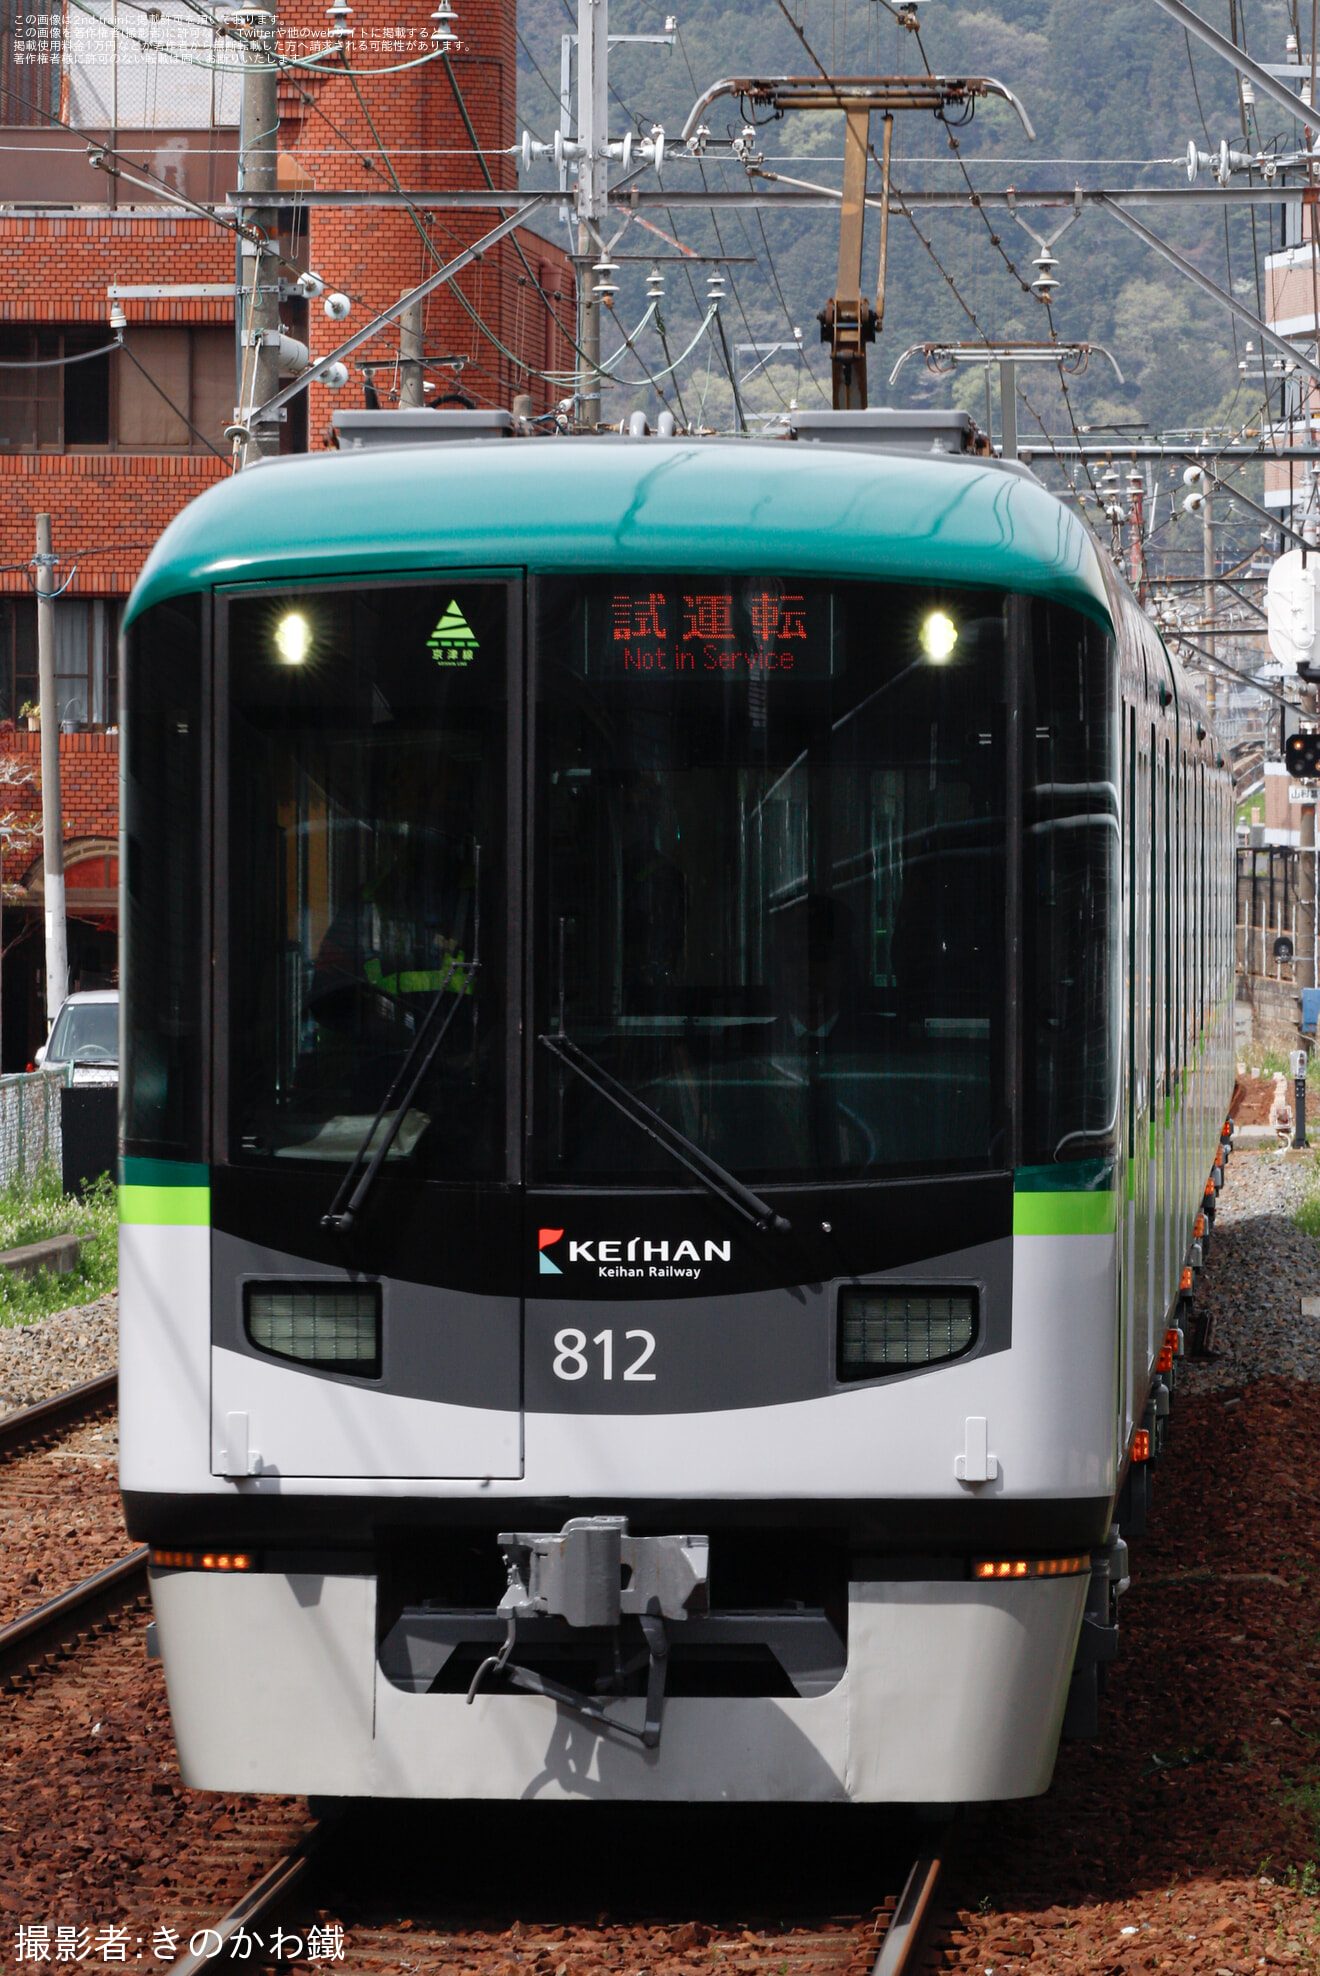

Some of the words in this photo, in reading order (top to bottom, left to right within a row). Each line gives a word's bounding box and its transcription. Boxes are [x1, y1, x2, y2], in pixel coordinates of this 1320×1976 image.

[612, 593, 807, 641] 試運転
[624, 647, 667, 670] Not
[675, 644, 695, 670] in
[703, 644, 794, 670] Service
[569, 1237, 731, 1262] KEIHAN
[598, 1266, 644, 1278] Keihan
[649, 1266, 701, 1280] Railway
[552, 1327, 657, 1381] 812
